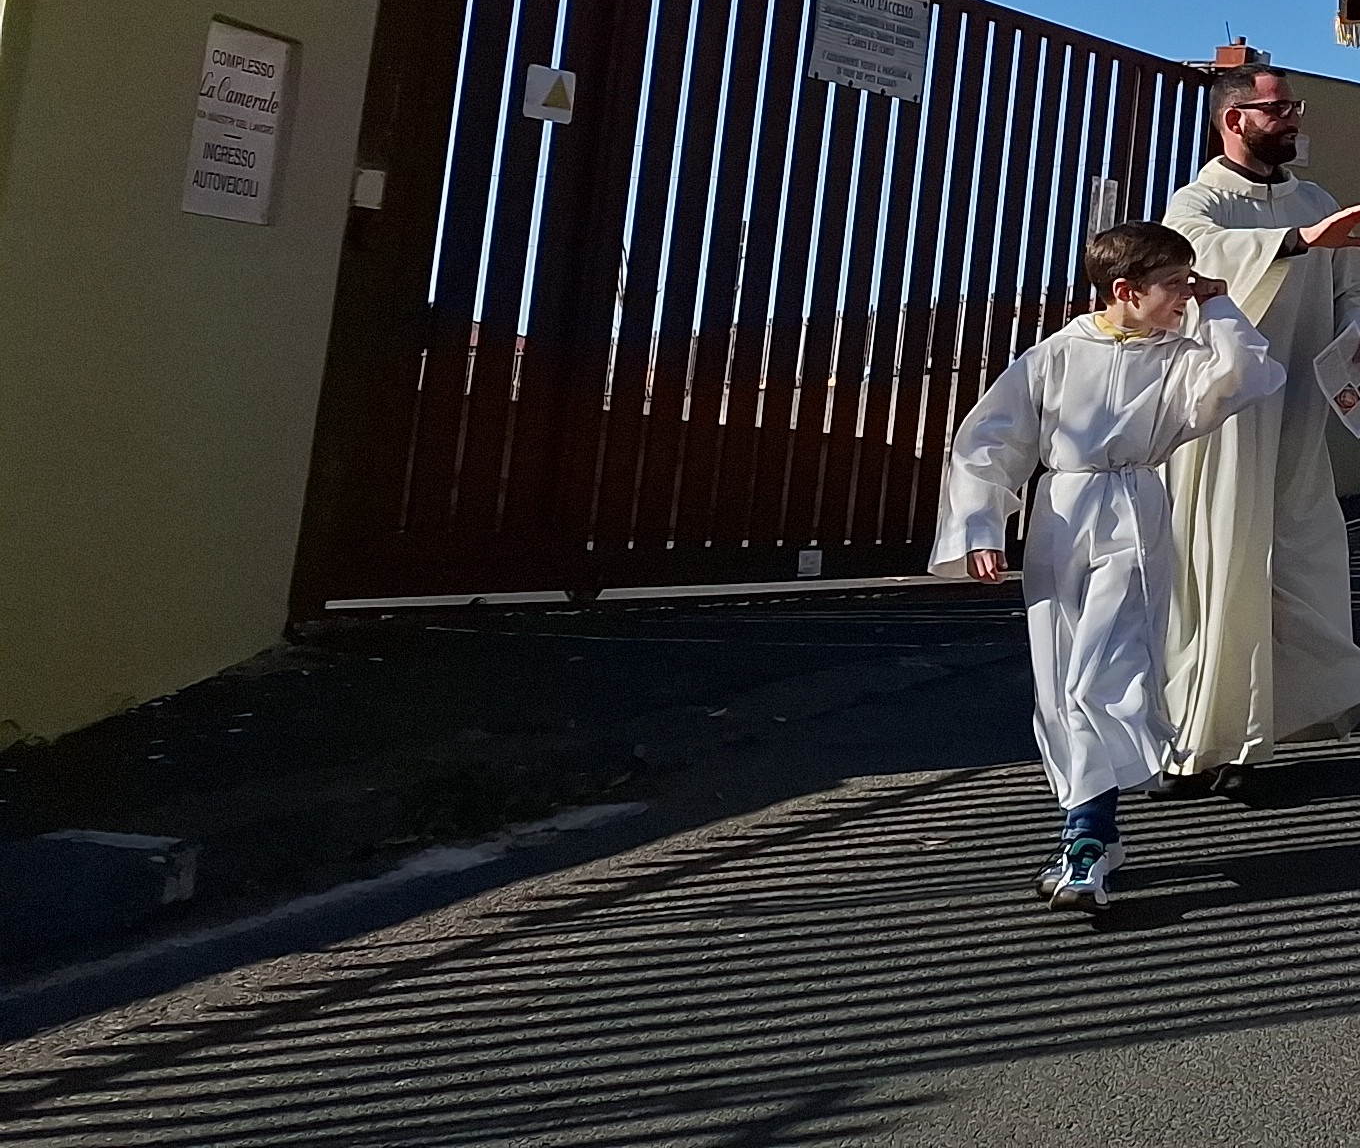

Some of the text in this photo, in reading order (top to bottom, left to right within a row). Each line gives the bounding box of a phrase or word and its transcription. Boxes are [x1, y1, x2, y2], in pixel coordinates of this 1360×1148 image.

[212, 50, 275, 79] COMPLESSO
[199, 71, 280, 114] La Camerale
[202, 142, 256, 169] INGRESSO
[192, 169, 259, 198] AUTOVEICOLI
